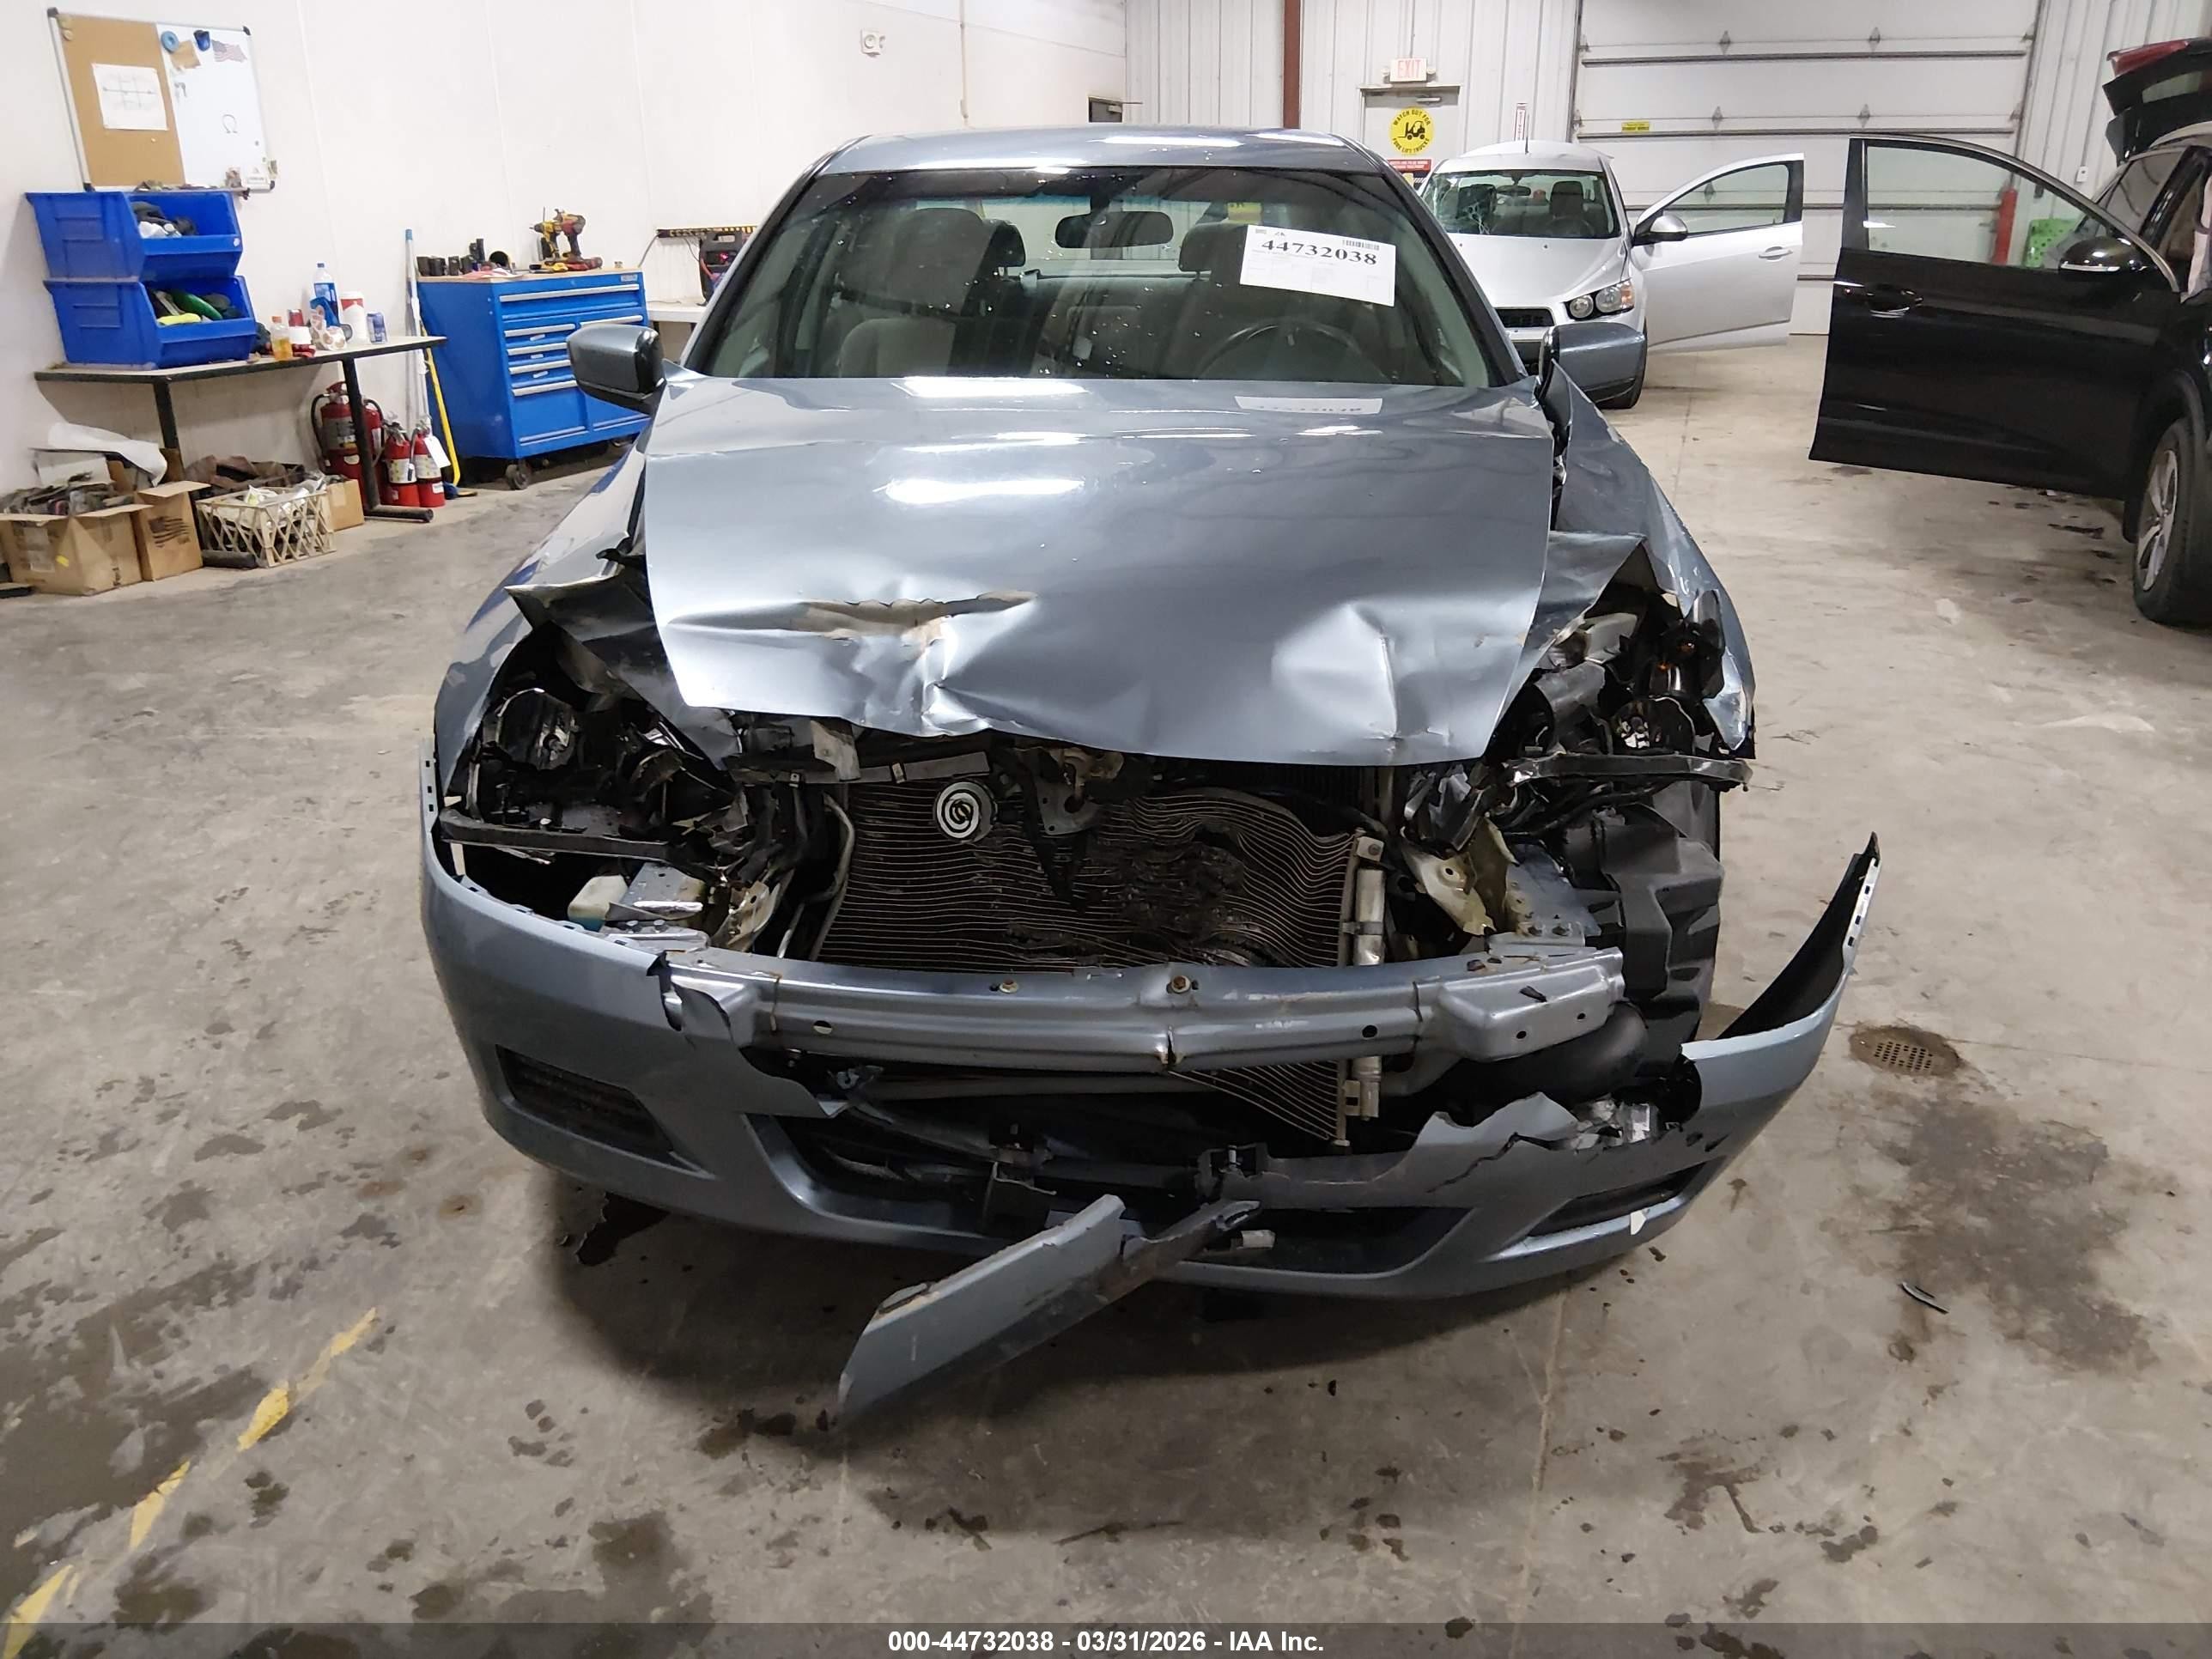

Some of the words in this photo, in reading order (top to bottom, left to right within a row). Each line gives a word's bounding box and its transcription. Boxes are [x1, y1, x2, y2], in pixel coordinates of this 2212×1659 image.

[1397, 59, 1422, 79] EXIT
[1393, 111, 1410, 125] WATCH
[1422, 114, 1431, 125] FOR
[1261, 240, 1377, 265] 44732038
